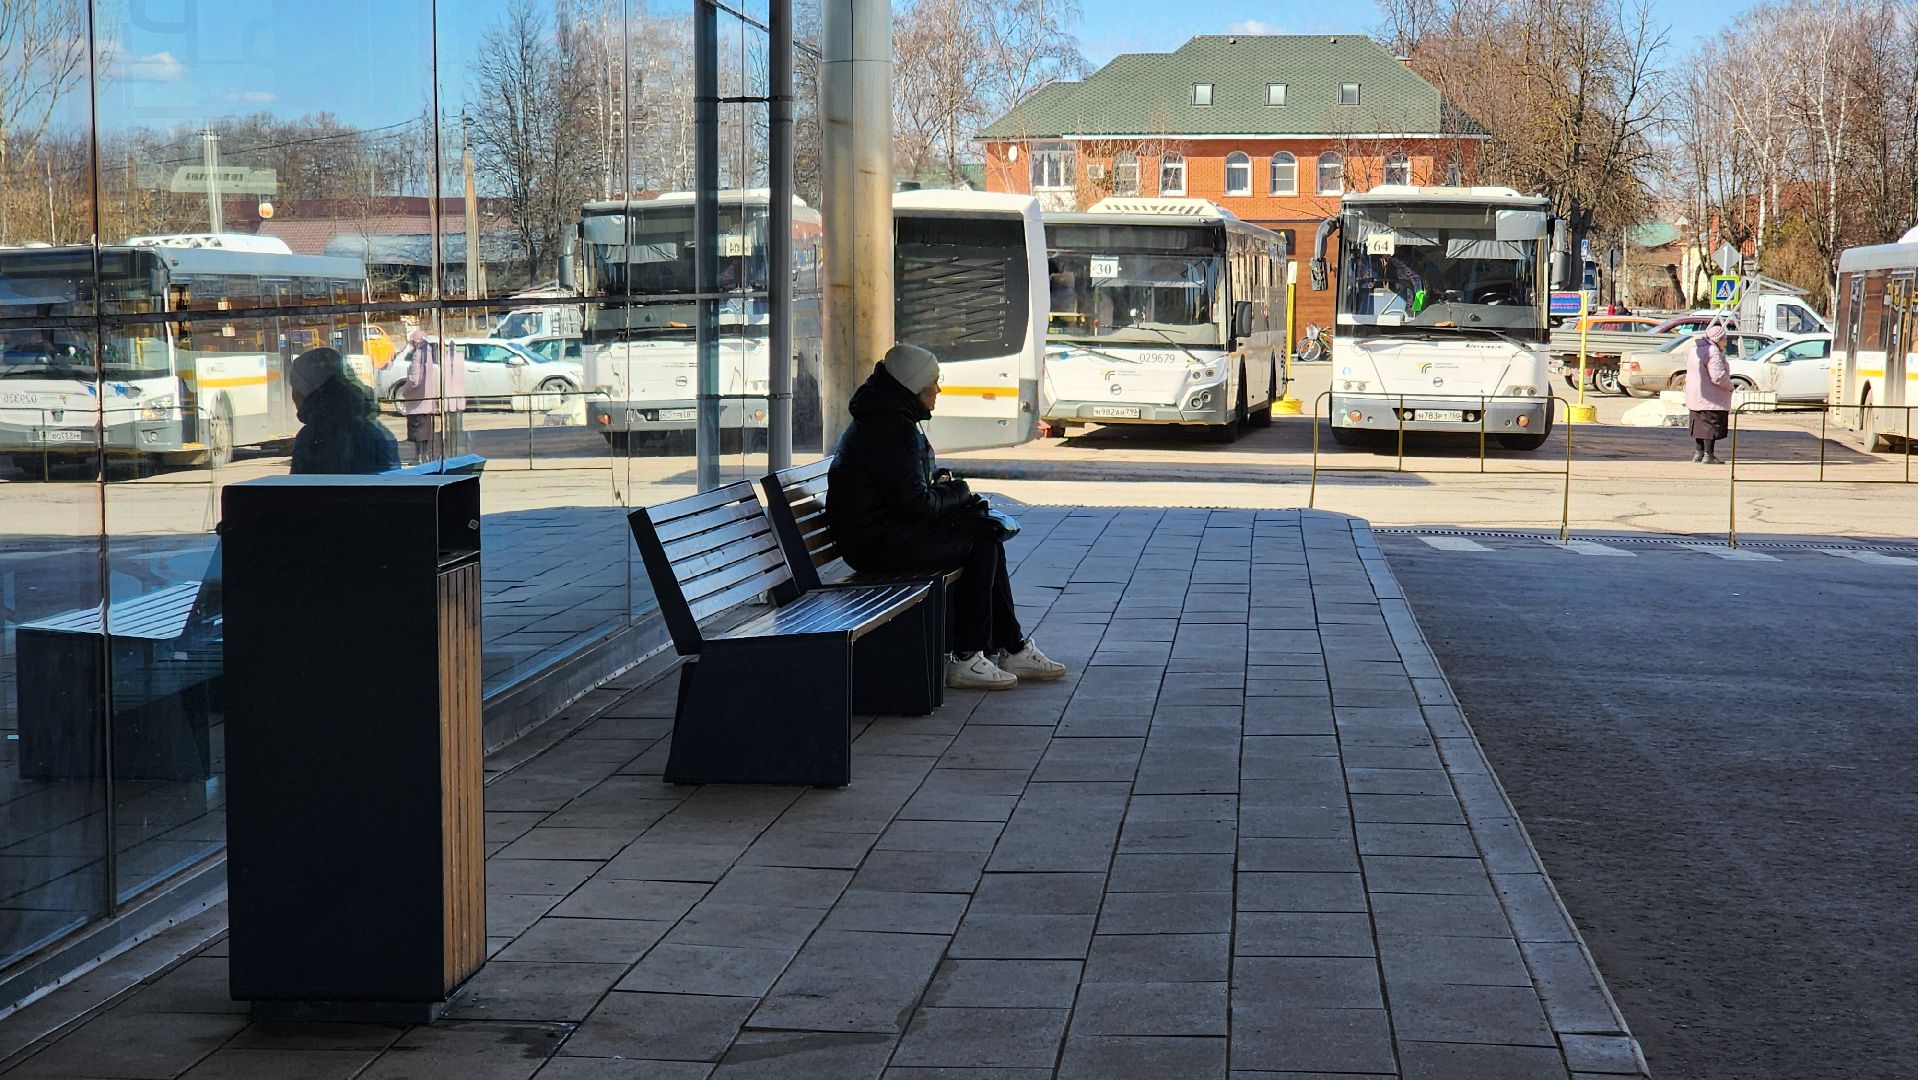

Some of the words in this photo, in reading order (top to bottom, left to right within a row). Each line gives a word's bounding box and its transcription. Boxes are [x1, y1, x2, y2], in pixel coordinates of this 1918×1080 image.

[1373, 240, 1389, 252] 64
[1096, 263, 1112, 275] 30
[1139, 352, 1176, 364] 029679
